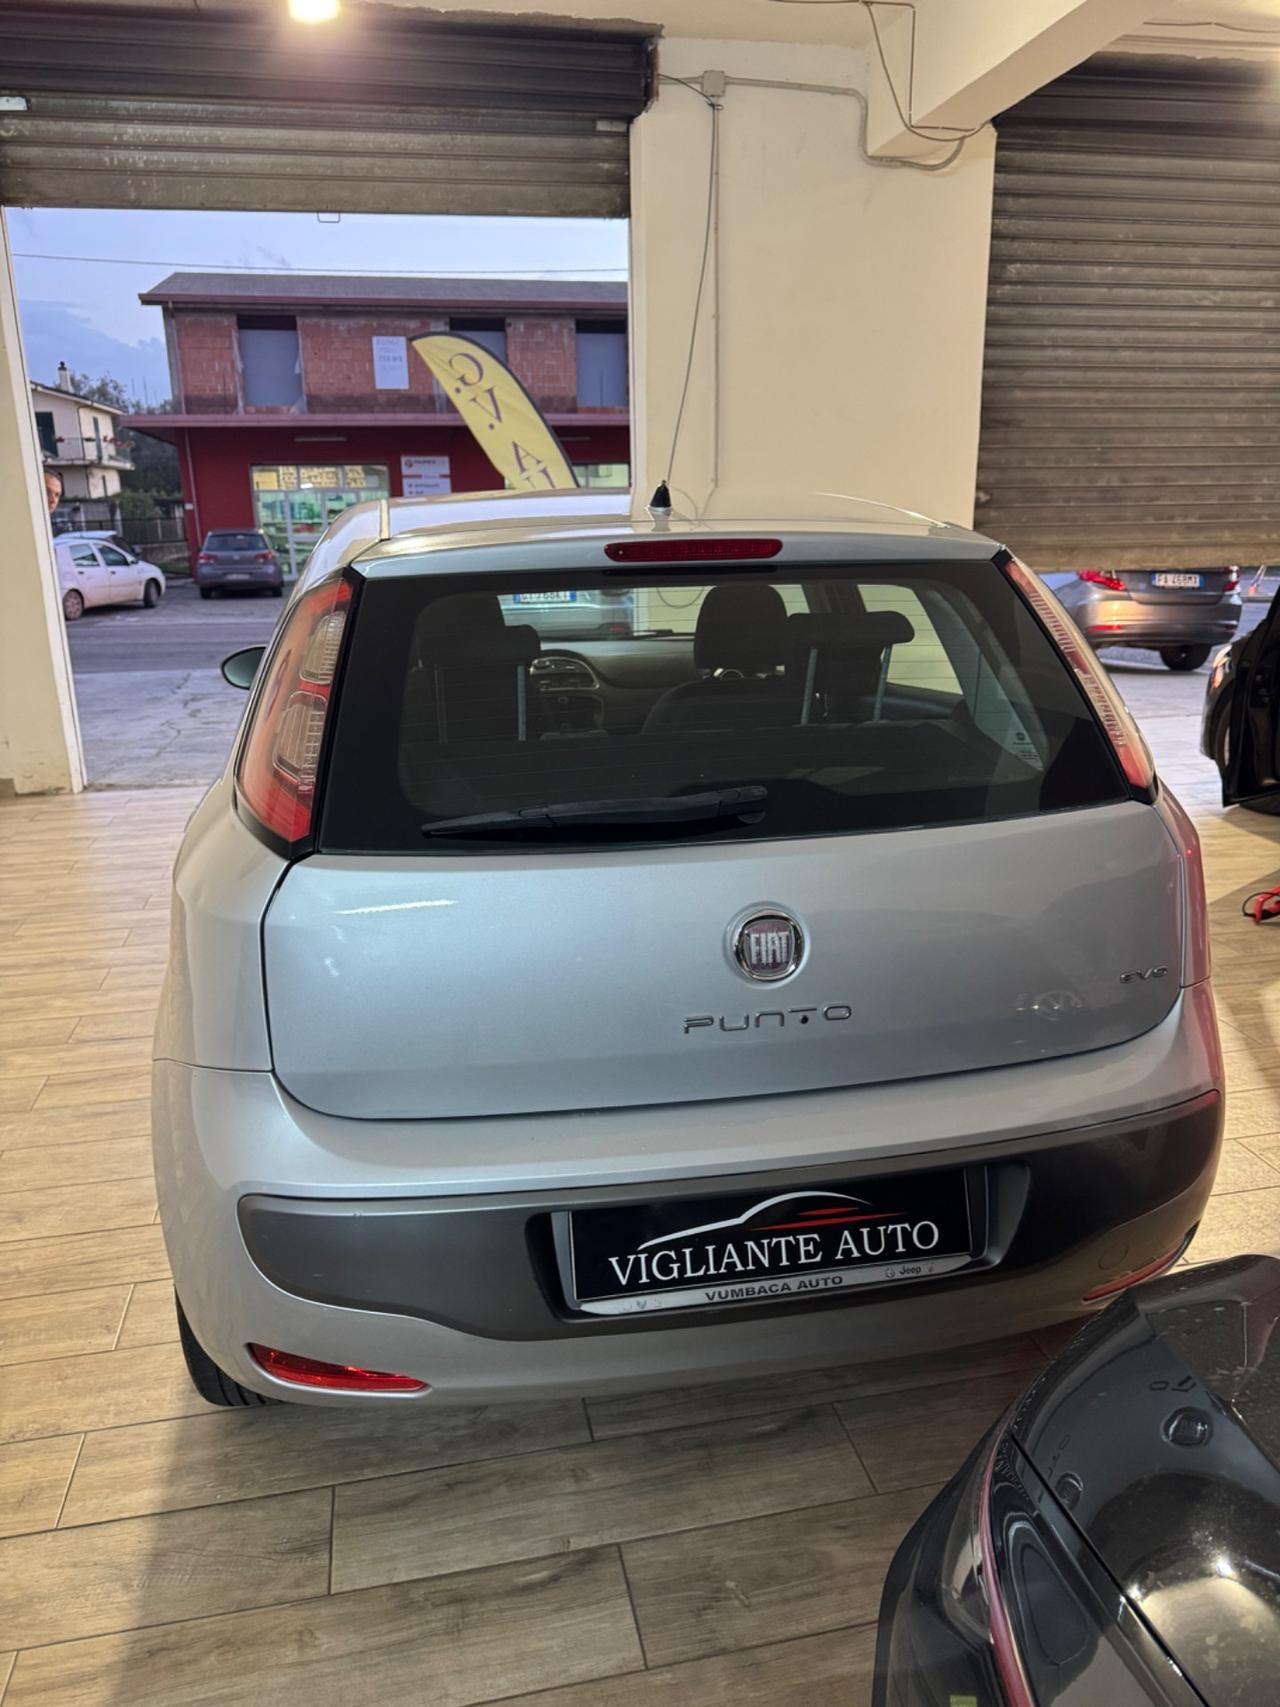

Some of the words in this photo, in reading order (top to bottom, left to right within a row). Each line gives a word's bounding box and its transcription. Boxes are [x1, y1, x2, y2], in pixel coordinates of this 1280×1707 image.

[750, 931, 790, 965] FIAT
[1119, 966, 1169, 985] EVO
[683, 1003, 852, 1034] PUNTO
[608, 1233, 823, 1286] VIGLIANTE
[834, 1220, 940, 1259] AUTO
[705, 1279, 791, 1303] VUMBACA
[797, 1275, 844, 1293] AUTO
